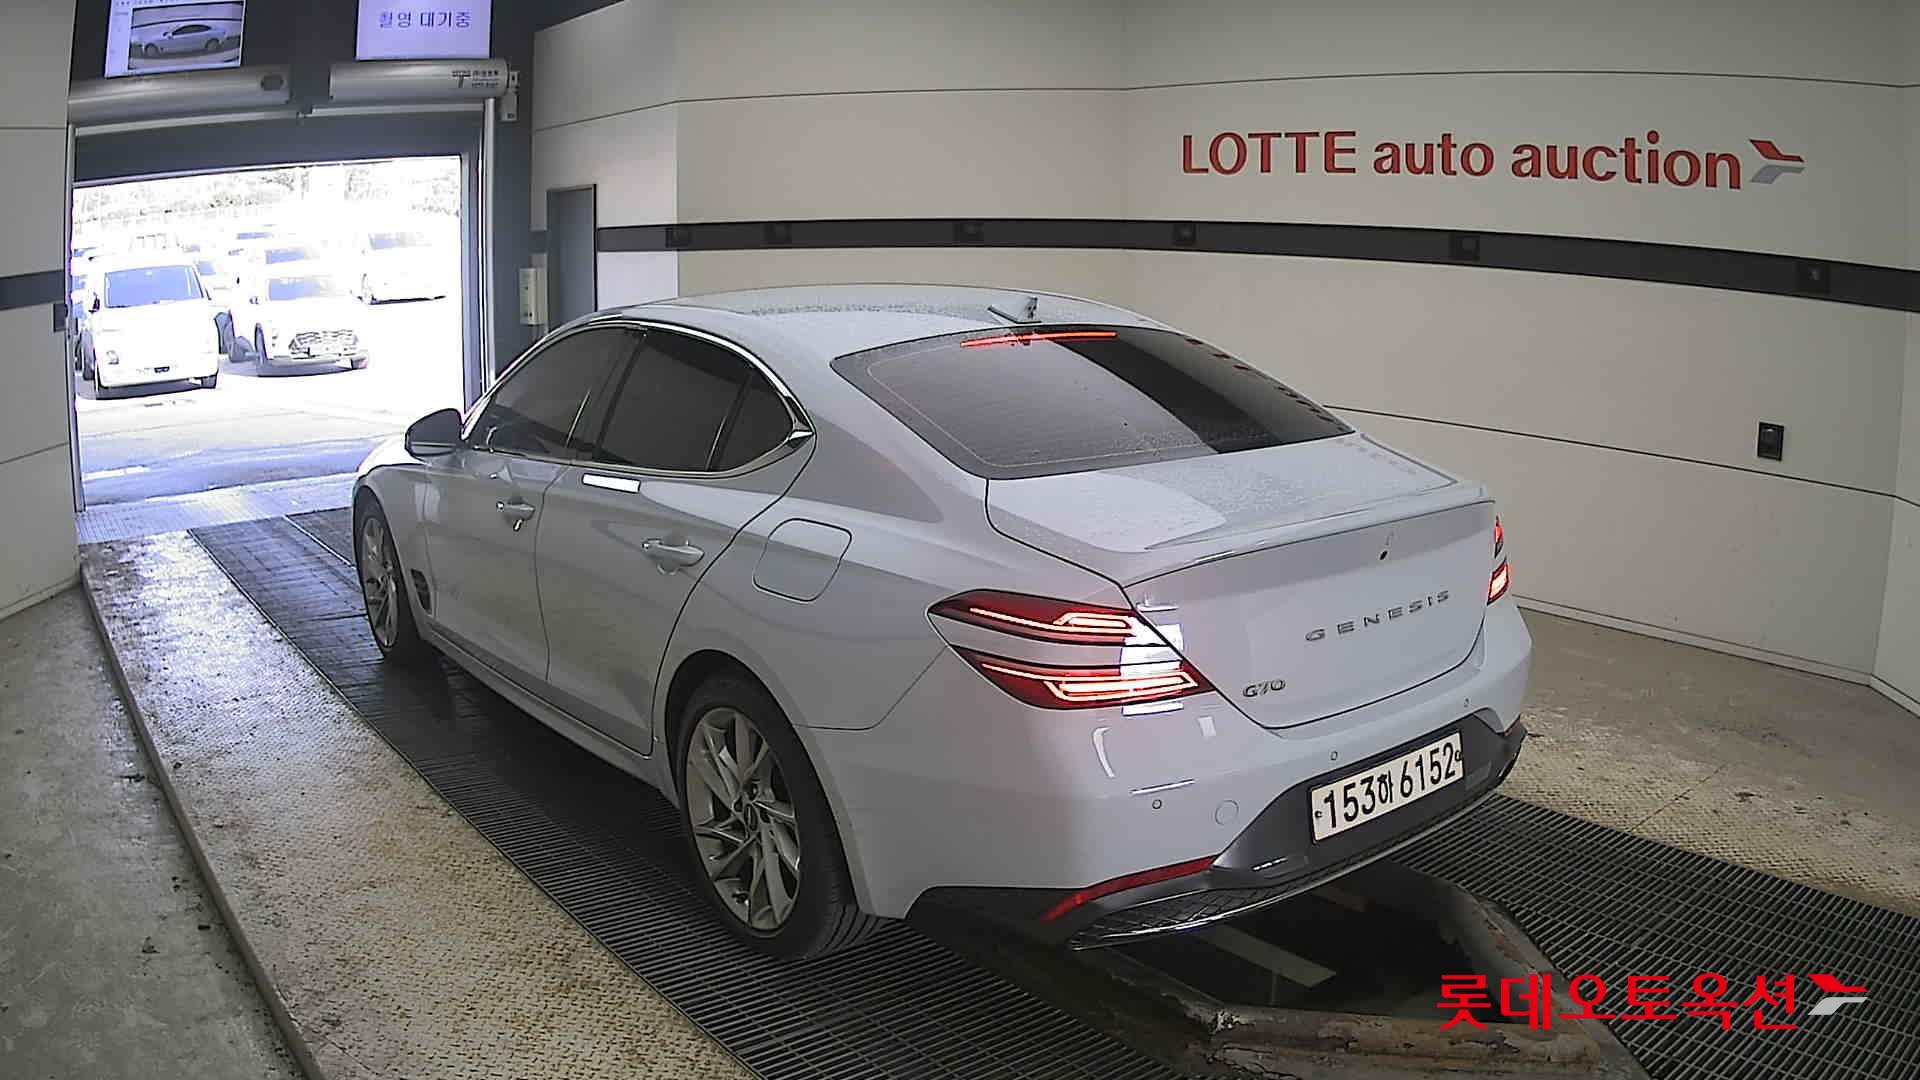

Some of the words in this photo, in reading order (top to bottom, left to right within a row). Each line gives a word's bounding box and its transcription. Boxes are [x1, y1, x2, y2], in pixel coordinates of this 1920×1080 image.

[420, 11, 471, 28] 대기중
[1182, 131, 1357, 175] LOTTE
[1373, 133, 1494, 176] auto
[1511, 130, 1741, 190] auction
[1305, 590, 1450, 642] GENESIS
[1242, 678, 1286, 698] G70
